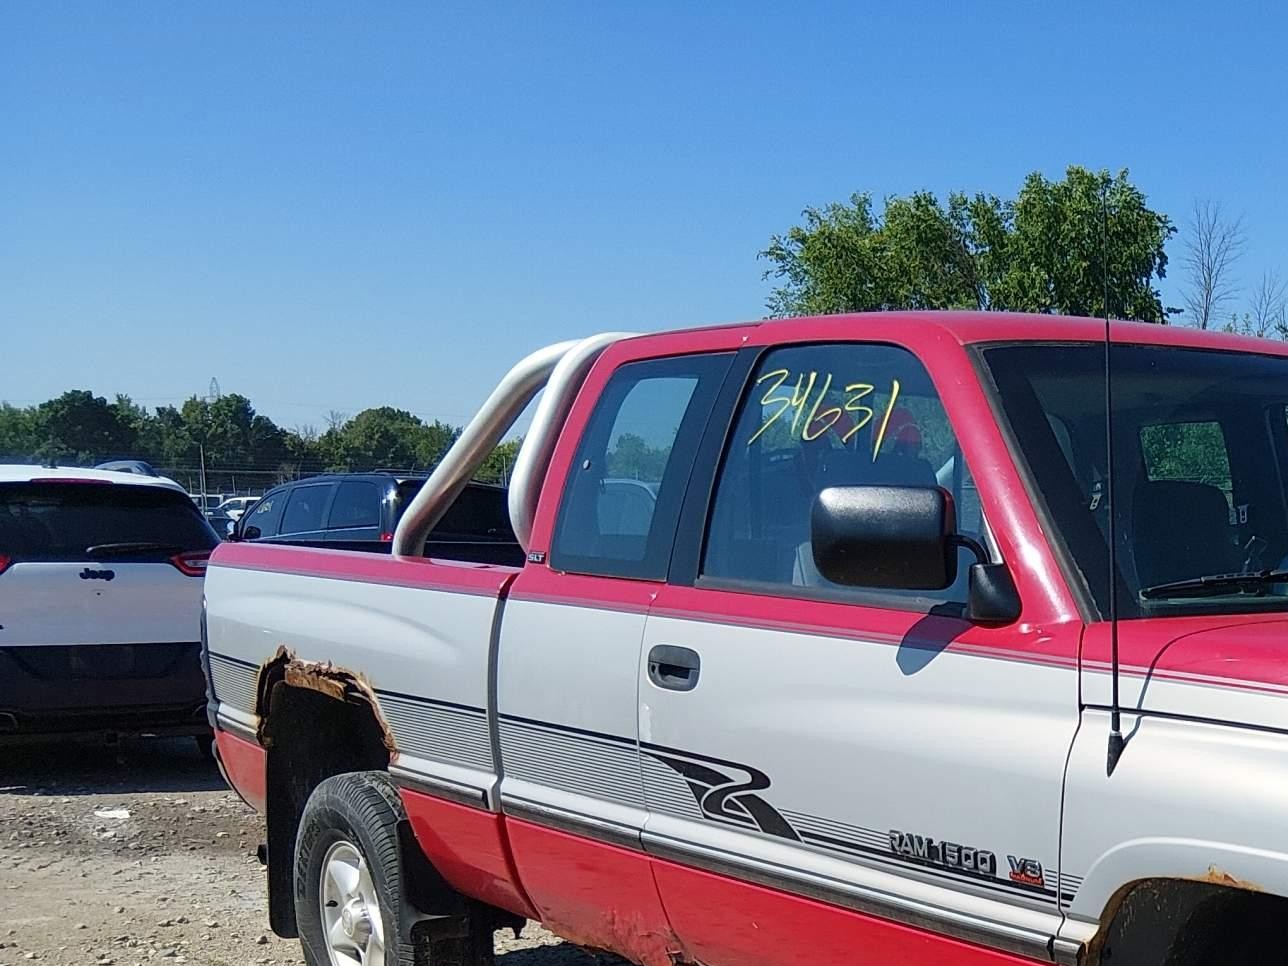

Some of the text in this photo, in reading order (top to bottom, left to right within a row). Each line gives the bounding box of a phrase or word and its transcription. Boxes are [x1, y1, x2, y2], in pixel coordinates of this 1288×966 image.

[747, 369, 900, 463] 34631
[527, 552, 546, 563] SLT
[79, 567, 115, 581] Jeep
[889, 829, 997, 875] RAM 1500
[1007, 855, 1042, 877] V8
